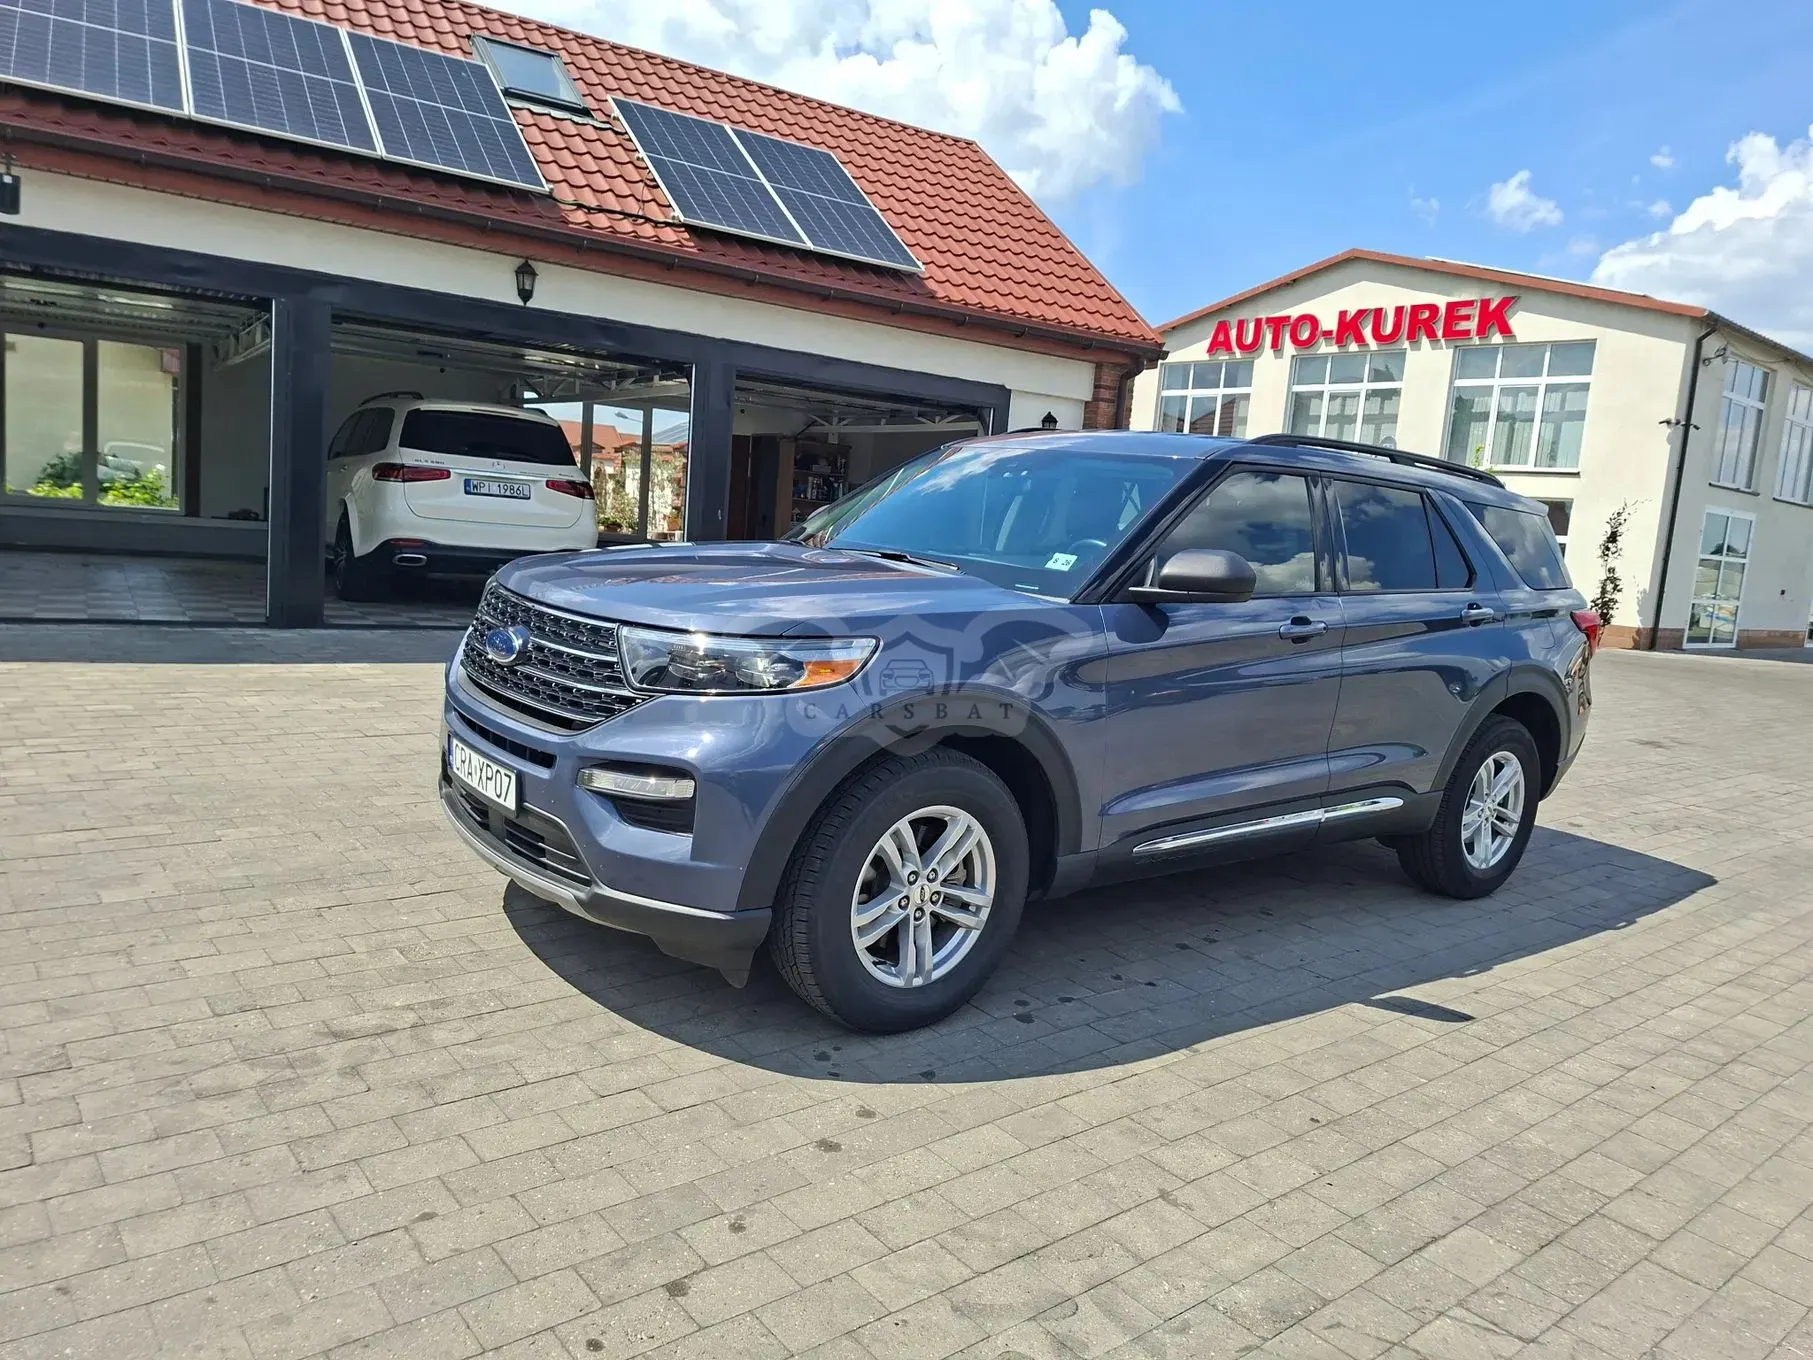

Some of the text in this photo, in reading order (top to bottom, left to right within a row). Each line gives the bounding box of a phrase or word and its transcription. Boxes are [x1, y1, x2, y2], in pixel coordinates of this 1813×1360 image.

[1206, 295, 1520, 355] AUTO-KUREK
[472, 481, 529, 497] WPI 1986L
[454, 743, 513, 803] CRA XP07
